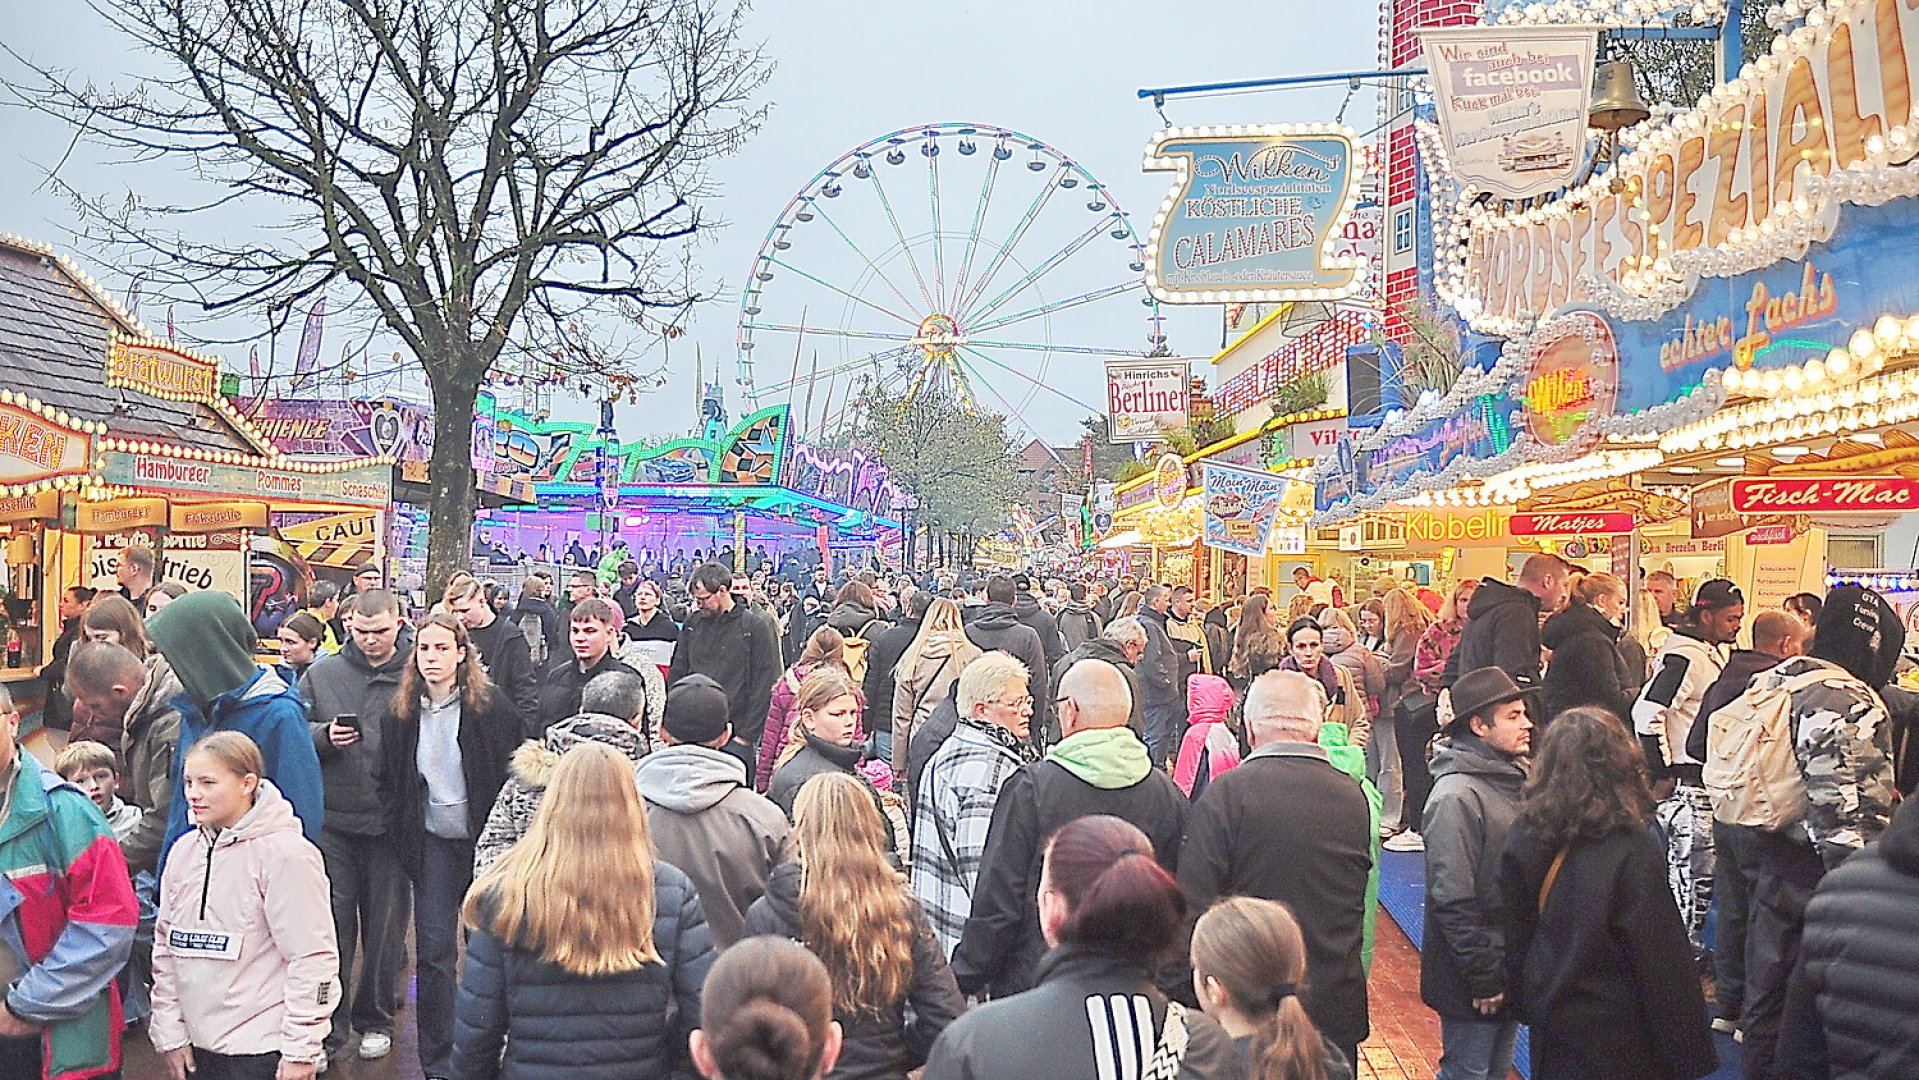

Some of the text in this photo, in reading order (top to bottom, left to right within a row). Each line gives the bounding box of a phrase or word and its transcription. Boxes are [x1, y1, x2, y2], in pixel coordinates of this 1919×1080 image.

[1439, 41, 1507, 62] Wir sind
[1488, 51, 1550, 70] auch bei
[1463, 63, 1574, 87] facebook
[1490, 88, 1513, 106] mal
[1186, 197, 1302, 218] KÖSTLICHE
[1174, 214, 1316, 270] CALAMARES
[1660, 261, 1837, 373] echter Lachs
[114, 346, 213, 396] Bratwurst
[1124, 370, 1170, 379] Hinrichs
[1109, 380, 1187, 414] Berliner
[136, 456, 210, 485] Hamburger
[256, 470, 303, 494] Pommes
[341, 479, 388, 500] Schaschlik
[1210, 475, 1278, 492] Moin Moin
[1742, 481, 1910, 509] Fisch-Mac
[92, 505, 151, 522] Hamburger
[1531, 514, 1606, 532] Matjes
[315, 516, 376, 540] CAUT
